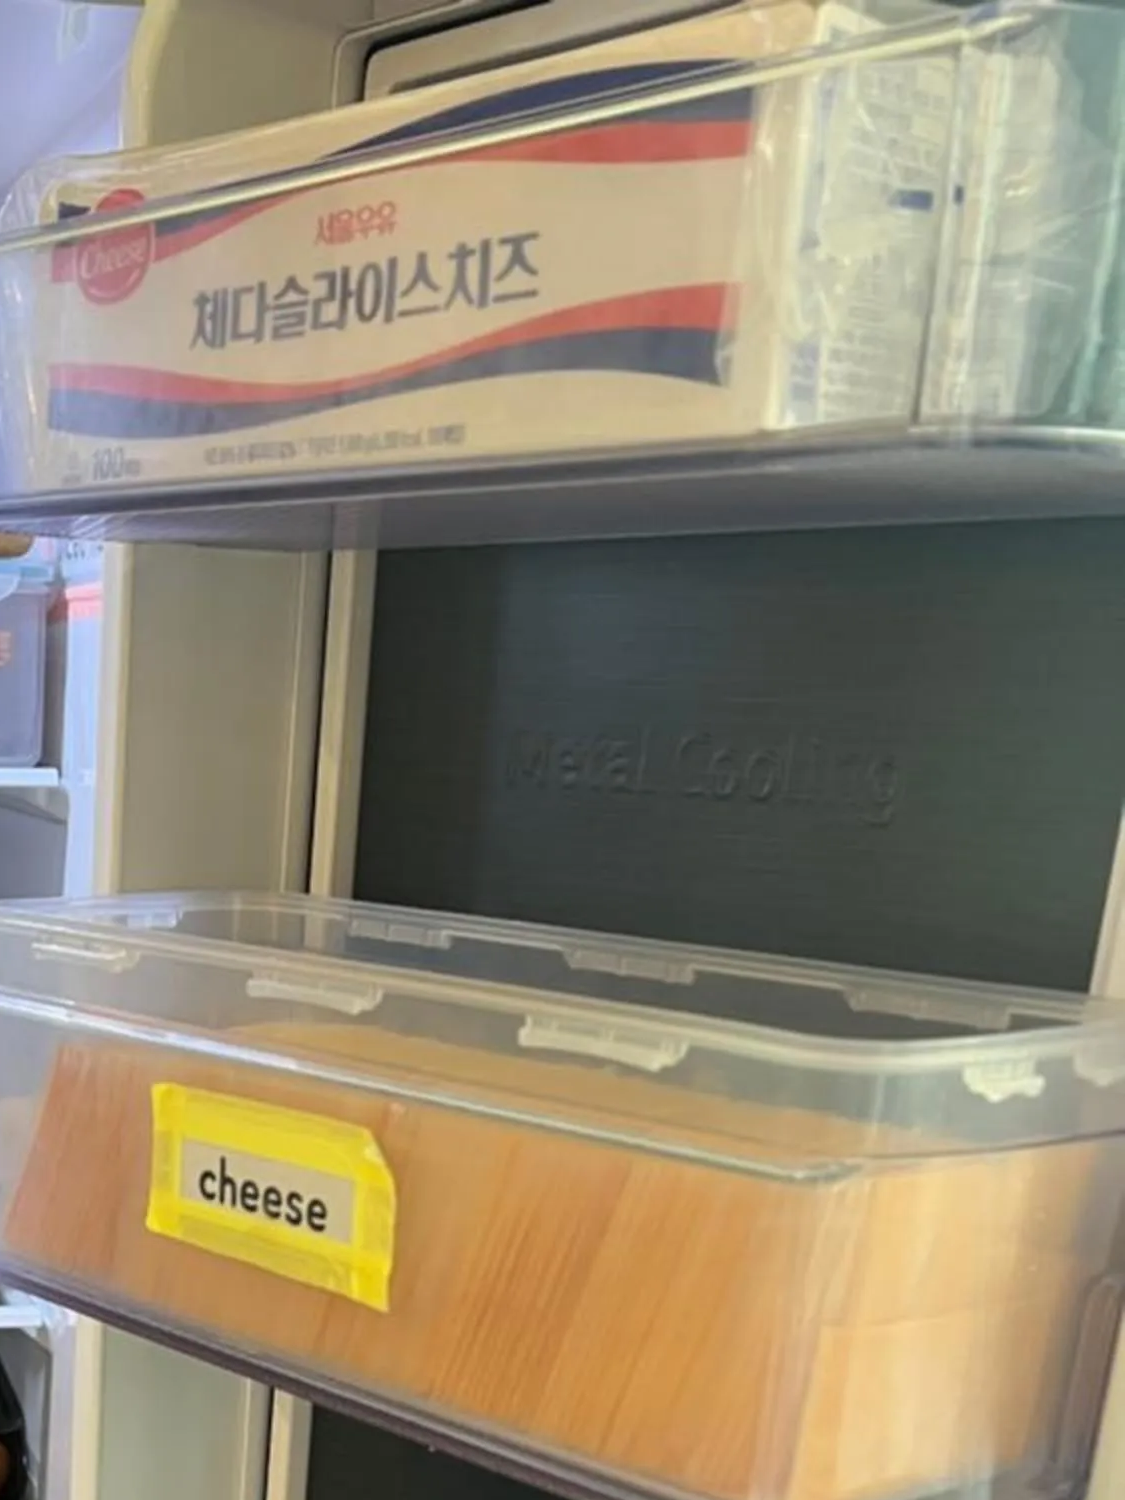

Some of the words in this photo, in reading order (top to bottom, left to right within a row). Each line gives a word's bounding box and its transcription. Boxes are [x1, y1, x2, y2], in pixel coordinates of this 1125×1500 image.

[79, 236, 146, 278] Cheese
[312, 201, 398, 247] 서울우유
[189, 231, 541, 350] 체다슬라이스치즈
[675, 726, 901, 829] Cooling
[198, 1155, 328, 1233] cheese
